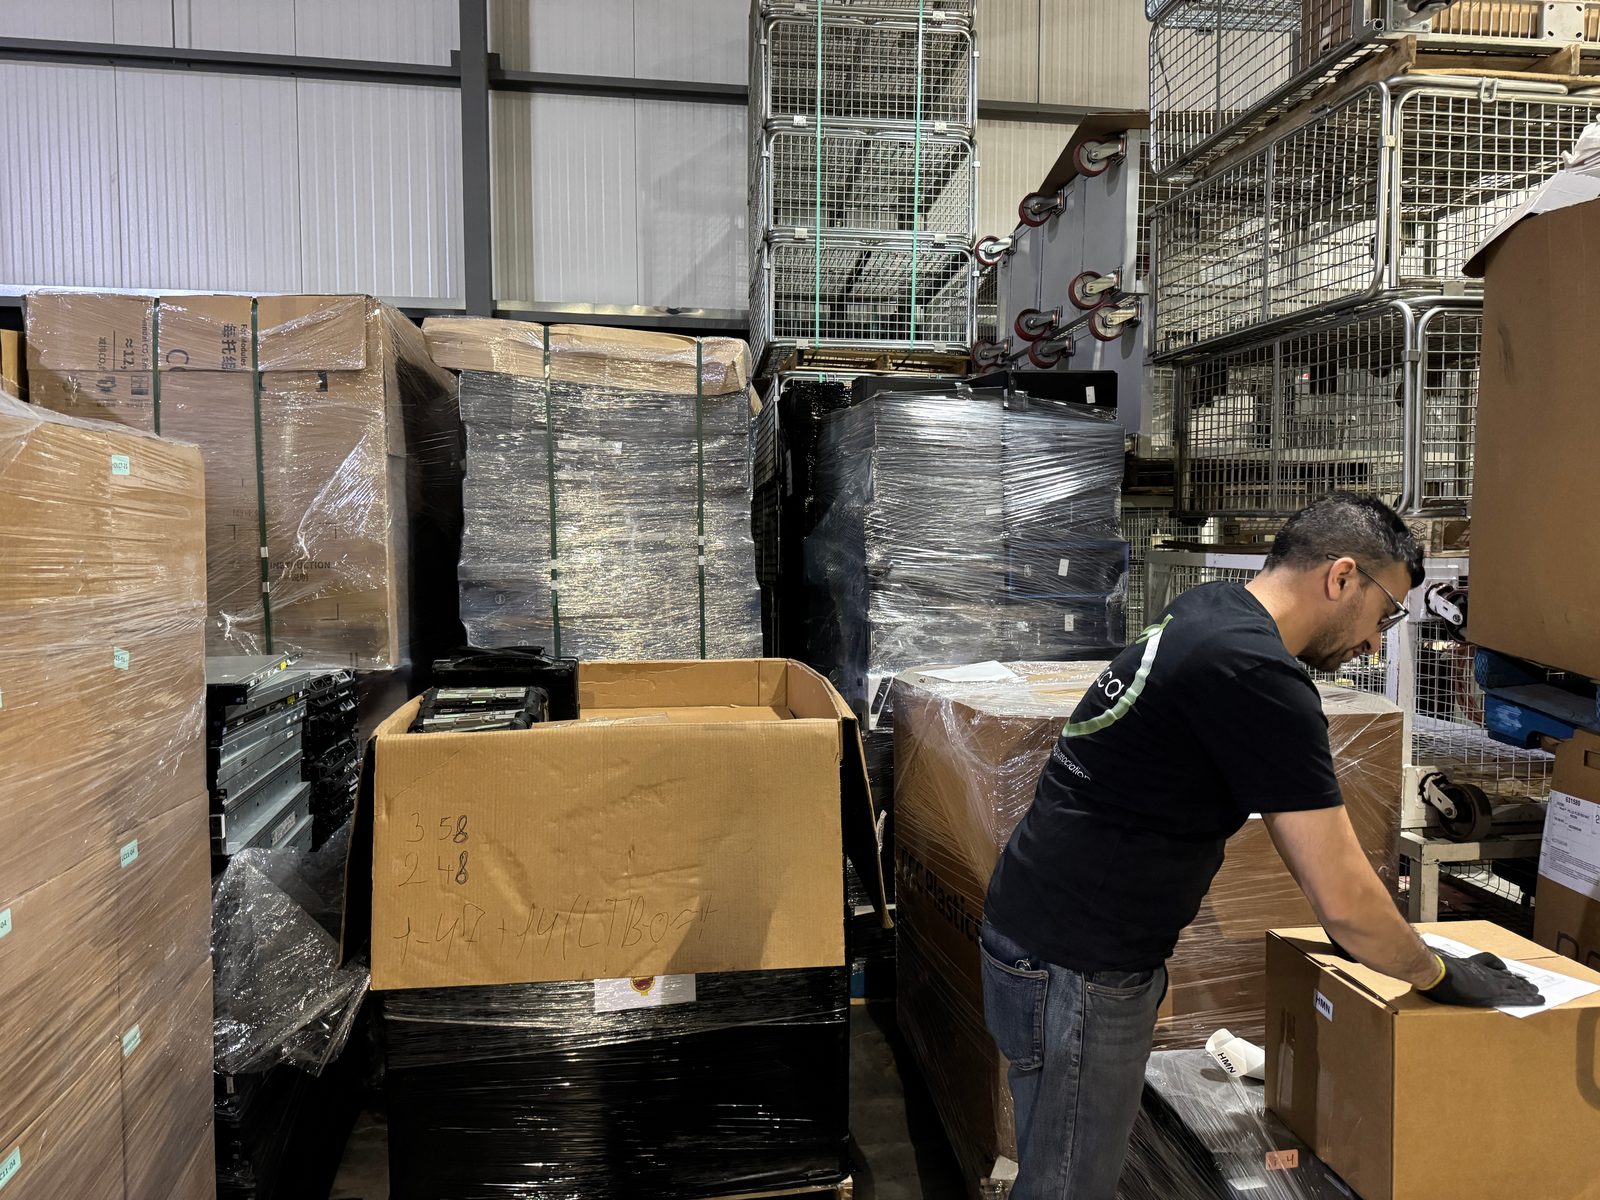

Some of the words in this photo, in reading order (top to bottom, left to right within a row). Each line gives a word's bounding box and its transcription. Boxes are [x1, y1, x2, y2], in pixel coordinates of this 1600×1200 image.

[405, 812, 425, 843] 3
[398, 851, 428, 887] 2
[1315, 993, 1331, 1015] HMN
[1217, 1052, 1236, 1074] HMN
